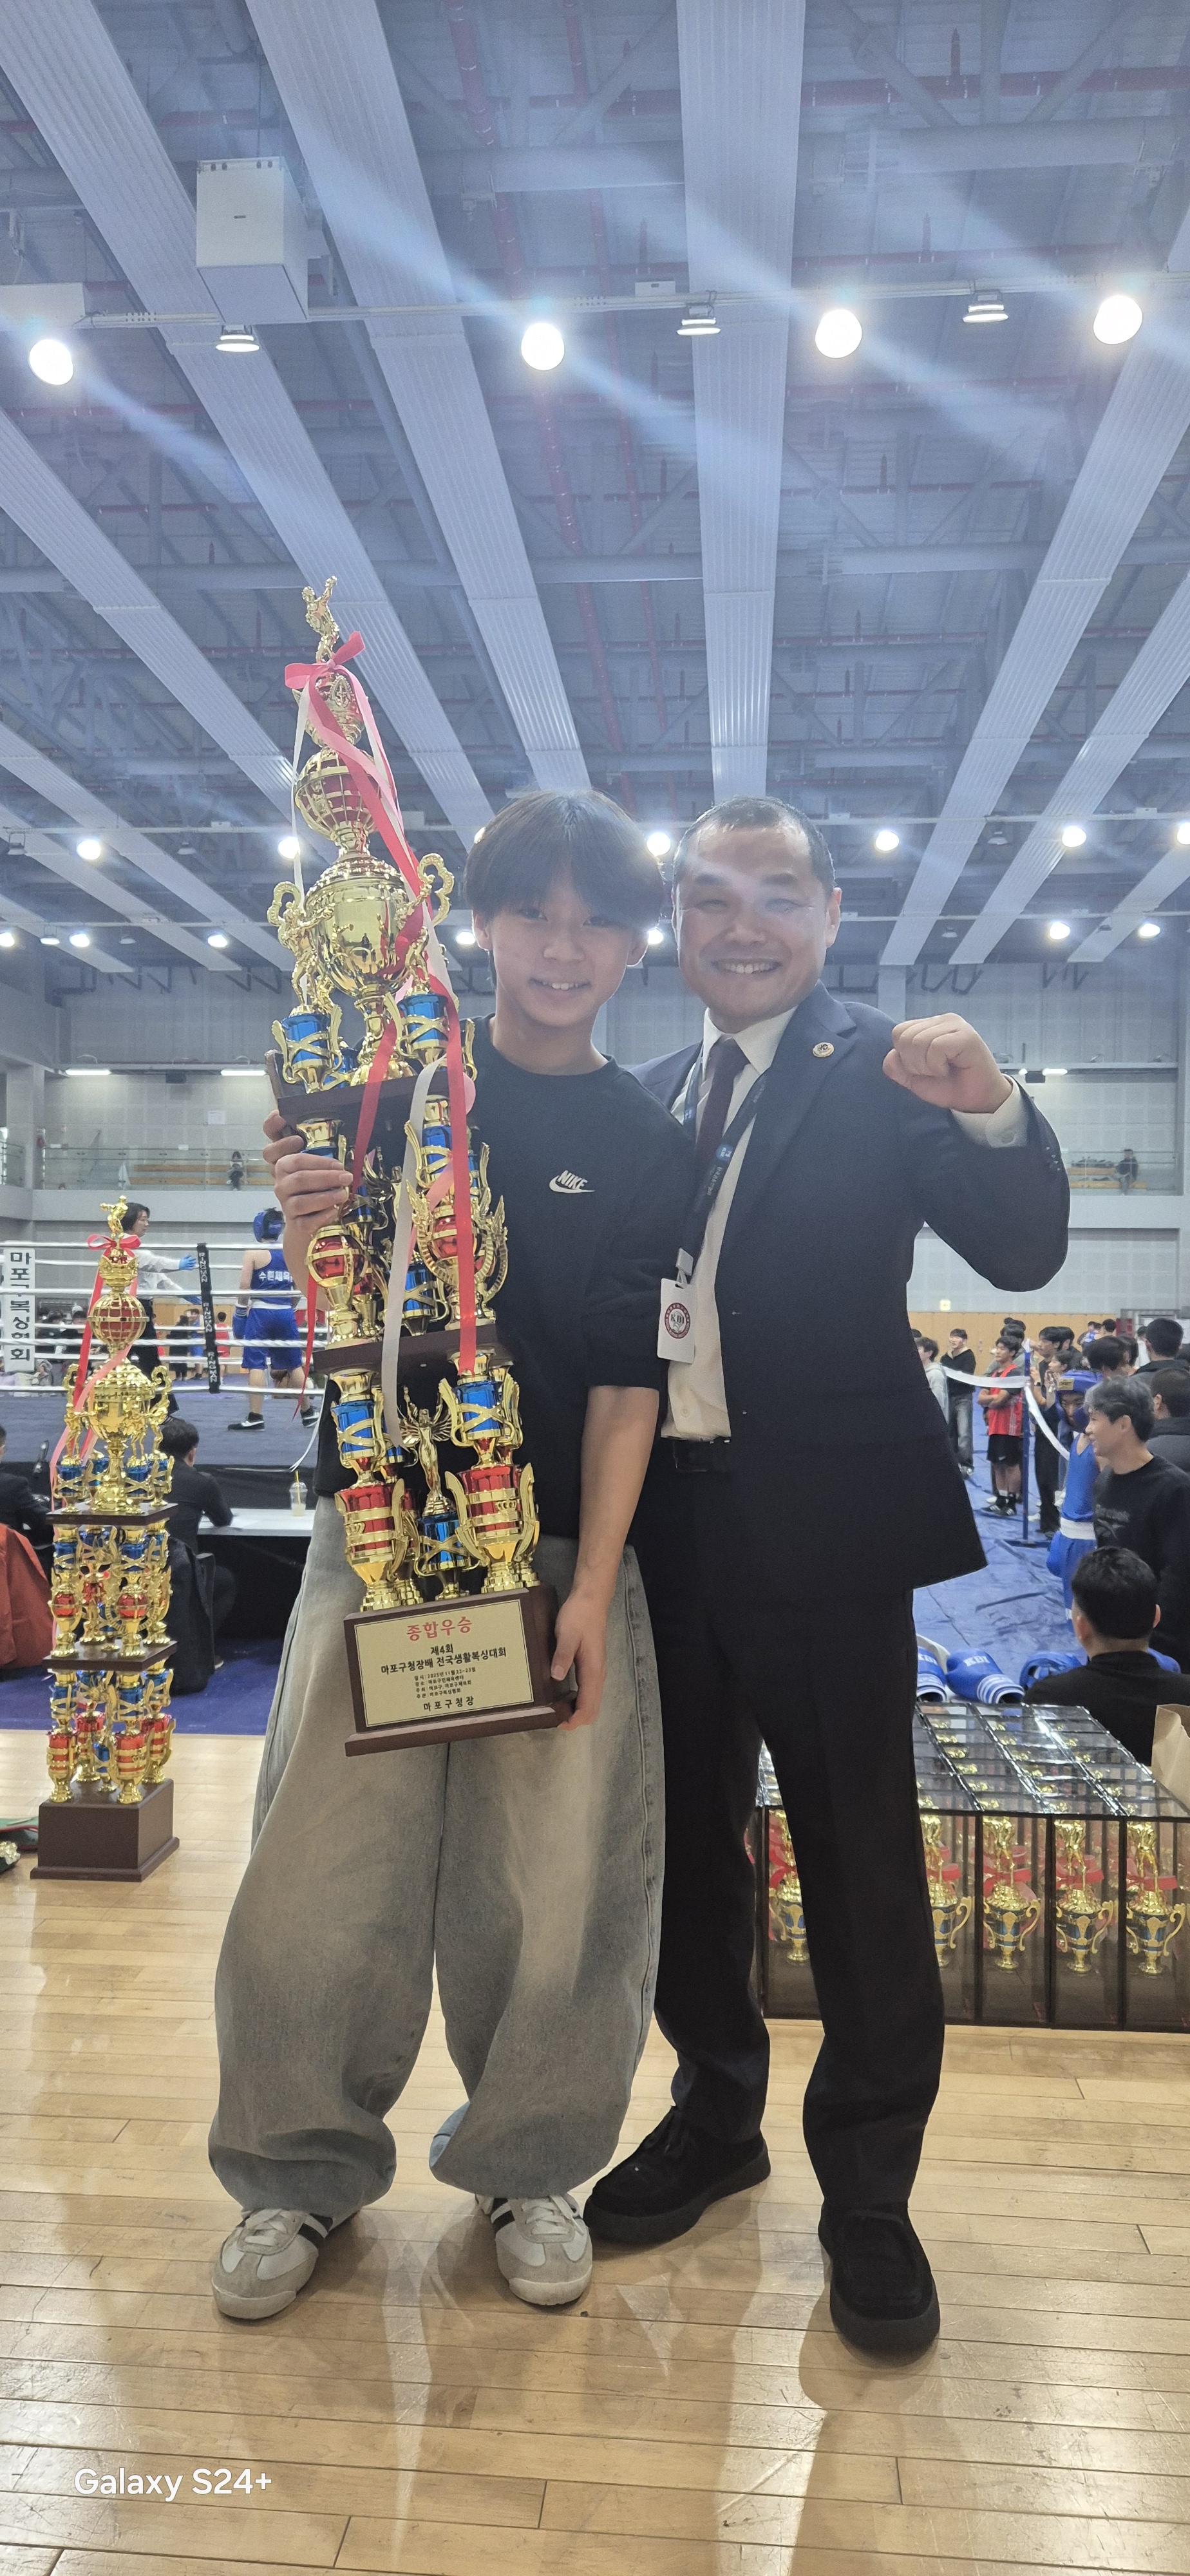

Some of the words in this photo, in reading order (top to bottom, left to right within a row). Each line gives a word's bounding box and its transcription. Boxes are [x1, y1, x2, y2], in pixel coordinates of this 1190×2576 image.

[557, 1170, 588, 1189] NIKE
[198, 1252, 208, 1283] RINGMAN
[203, 1302, 213, 1333] RINGMAN
[207, 1352, 218, 1383] RINGMAN
[406, 1616, 472, 1642] 종합우승
[381, 1658, 434, 1675] 마포구청장배
[436, 1647, 507, 1667] 전국생활복싱대회
[430, 1643, 454, 1656] 제4회
[963, 1656, 990, 1667] KBI
